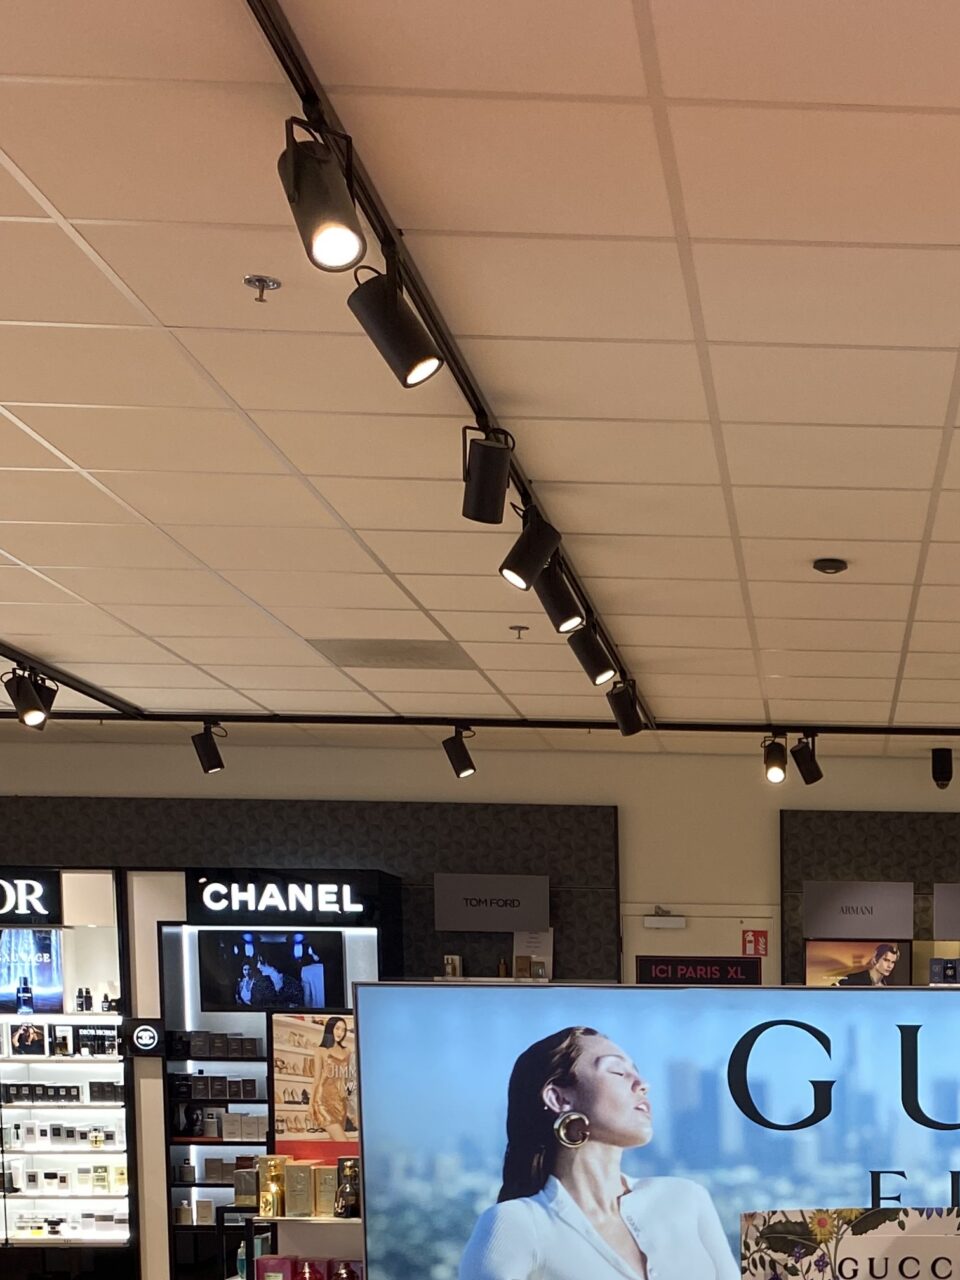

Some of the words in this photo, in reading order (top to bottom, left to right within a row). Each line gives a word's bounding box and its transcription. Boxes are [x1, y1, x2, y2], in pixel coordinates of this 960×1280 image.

[202, 882, 364, 912] CHANEL
[463, 897, 488, 908] TOM
[489, 898, 521, 908] FORD
[839, 905, 874, 915] ARMANI
[652, 965, 672, 978] ICI
[677, 966, 720, 979] PARIS
[727, 966, 746, 979] XL
